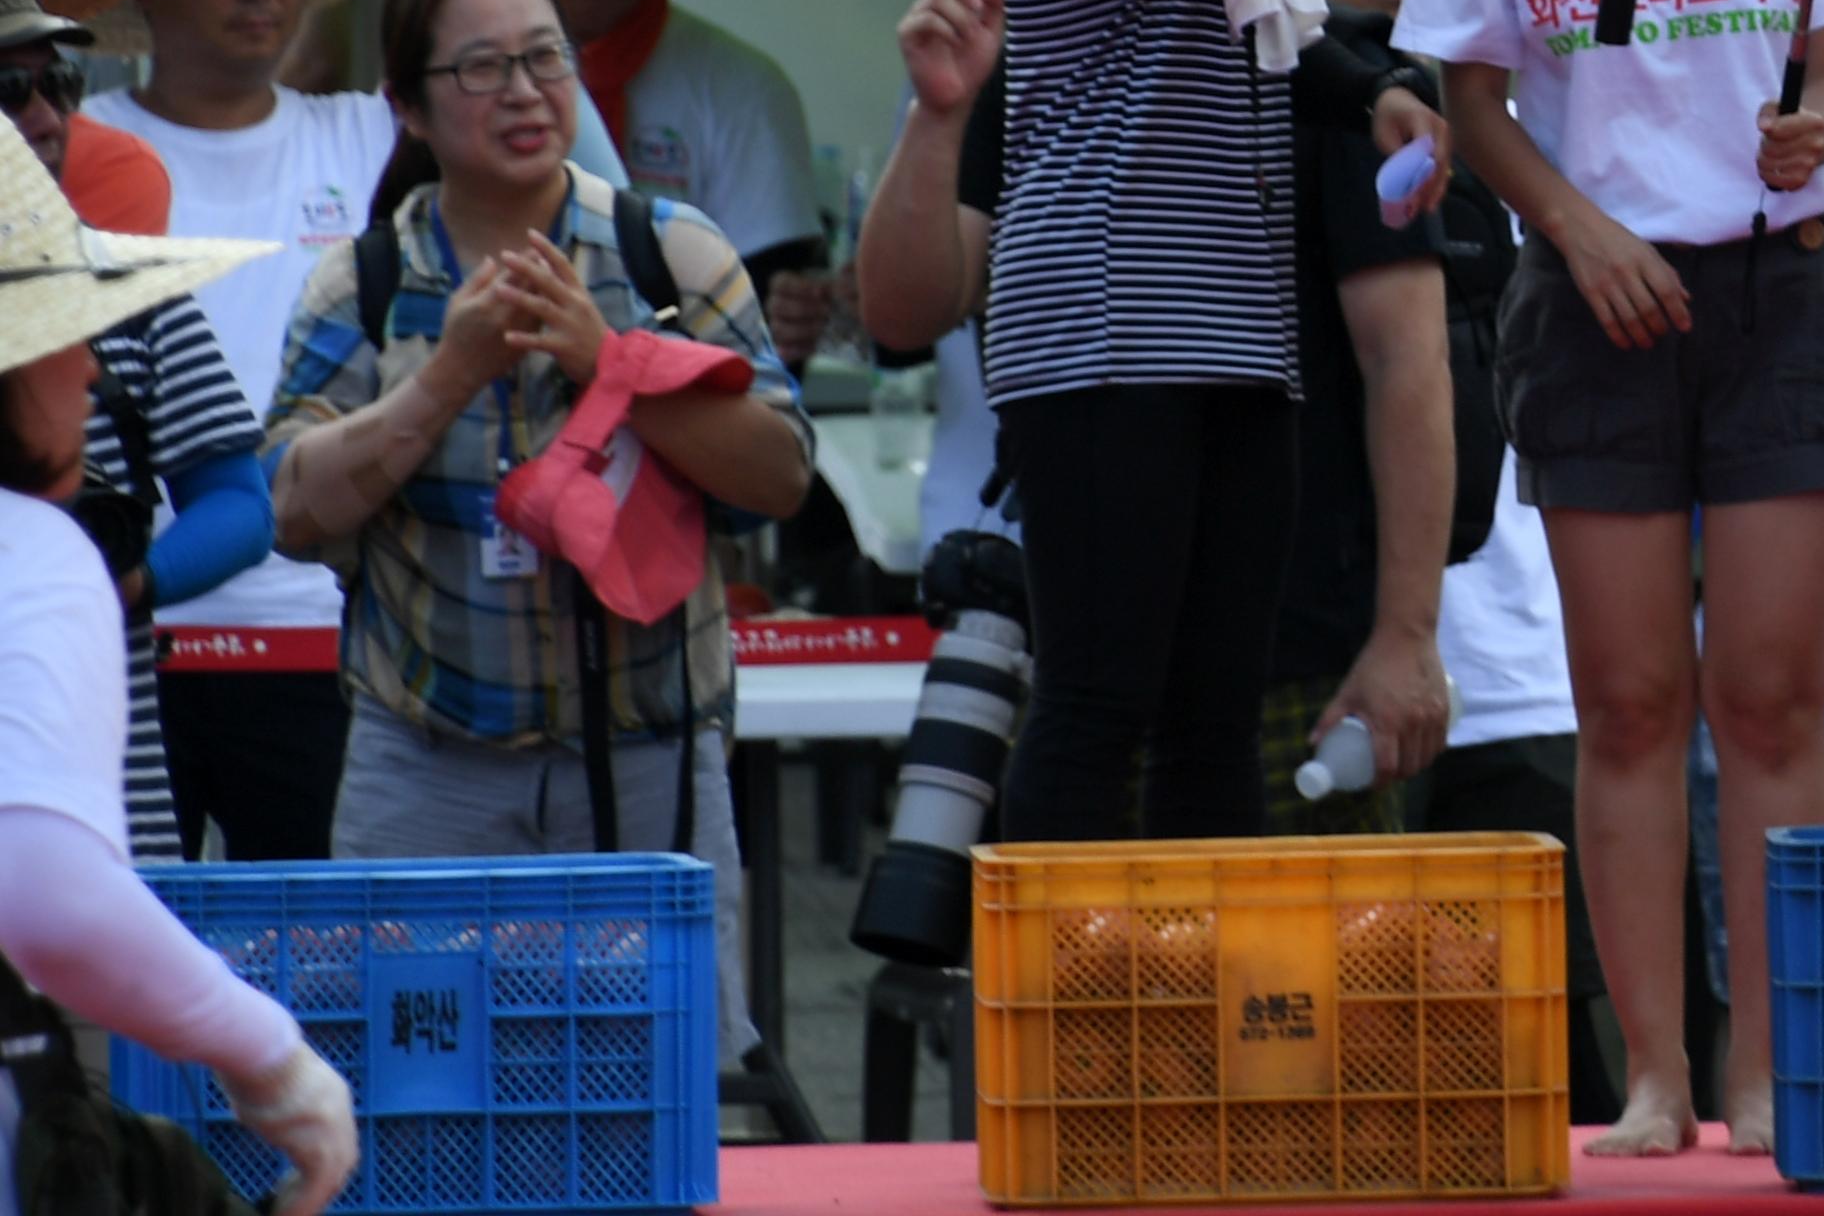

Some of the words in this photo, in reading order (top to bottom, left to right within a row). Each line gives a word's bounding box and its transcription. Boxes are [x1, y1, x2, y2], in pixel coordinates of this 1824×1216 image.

[1545, 22, 1661, 57] TOMO
[1667, 8, 1802, 41] FESTIVA
[391, 989, 458, 1055] 화악산
